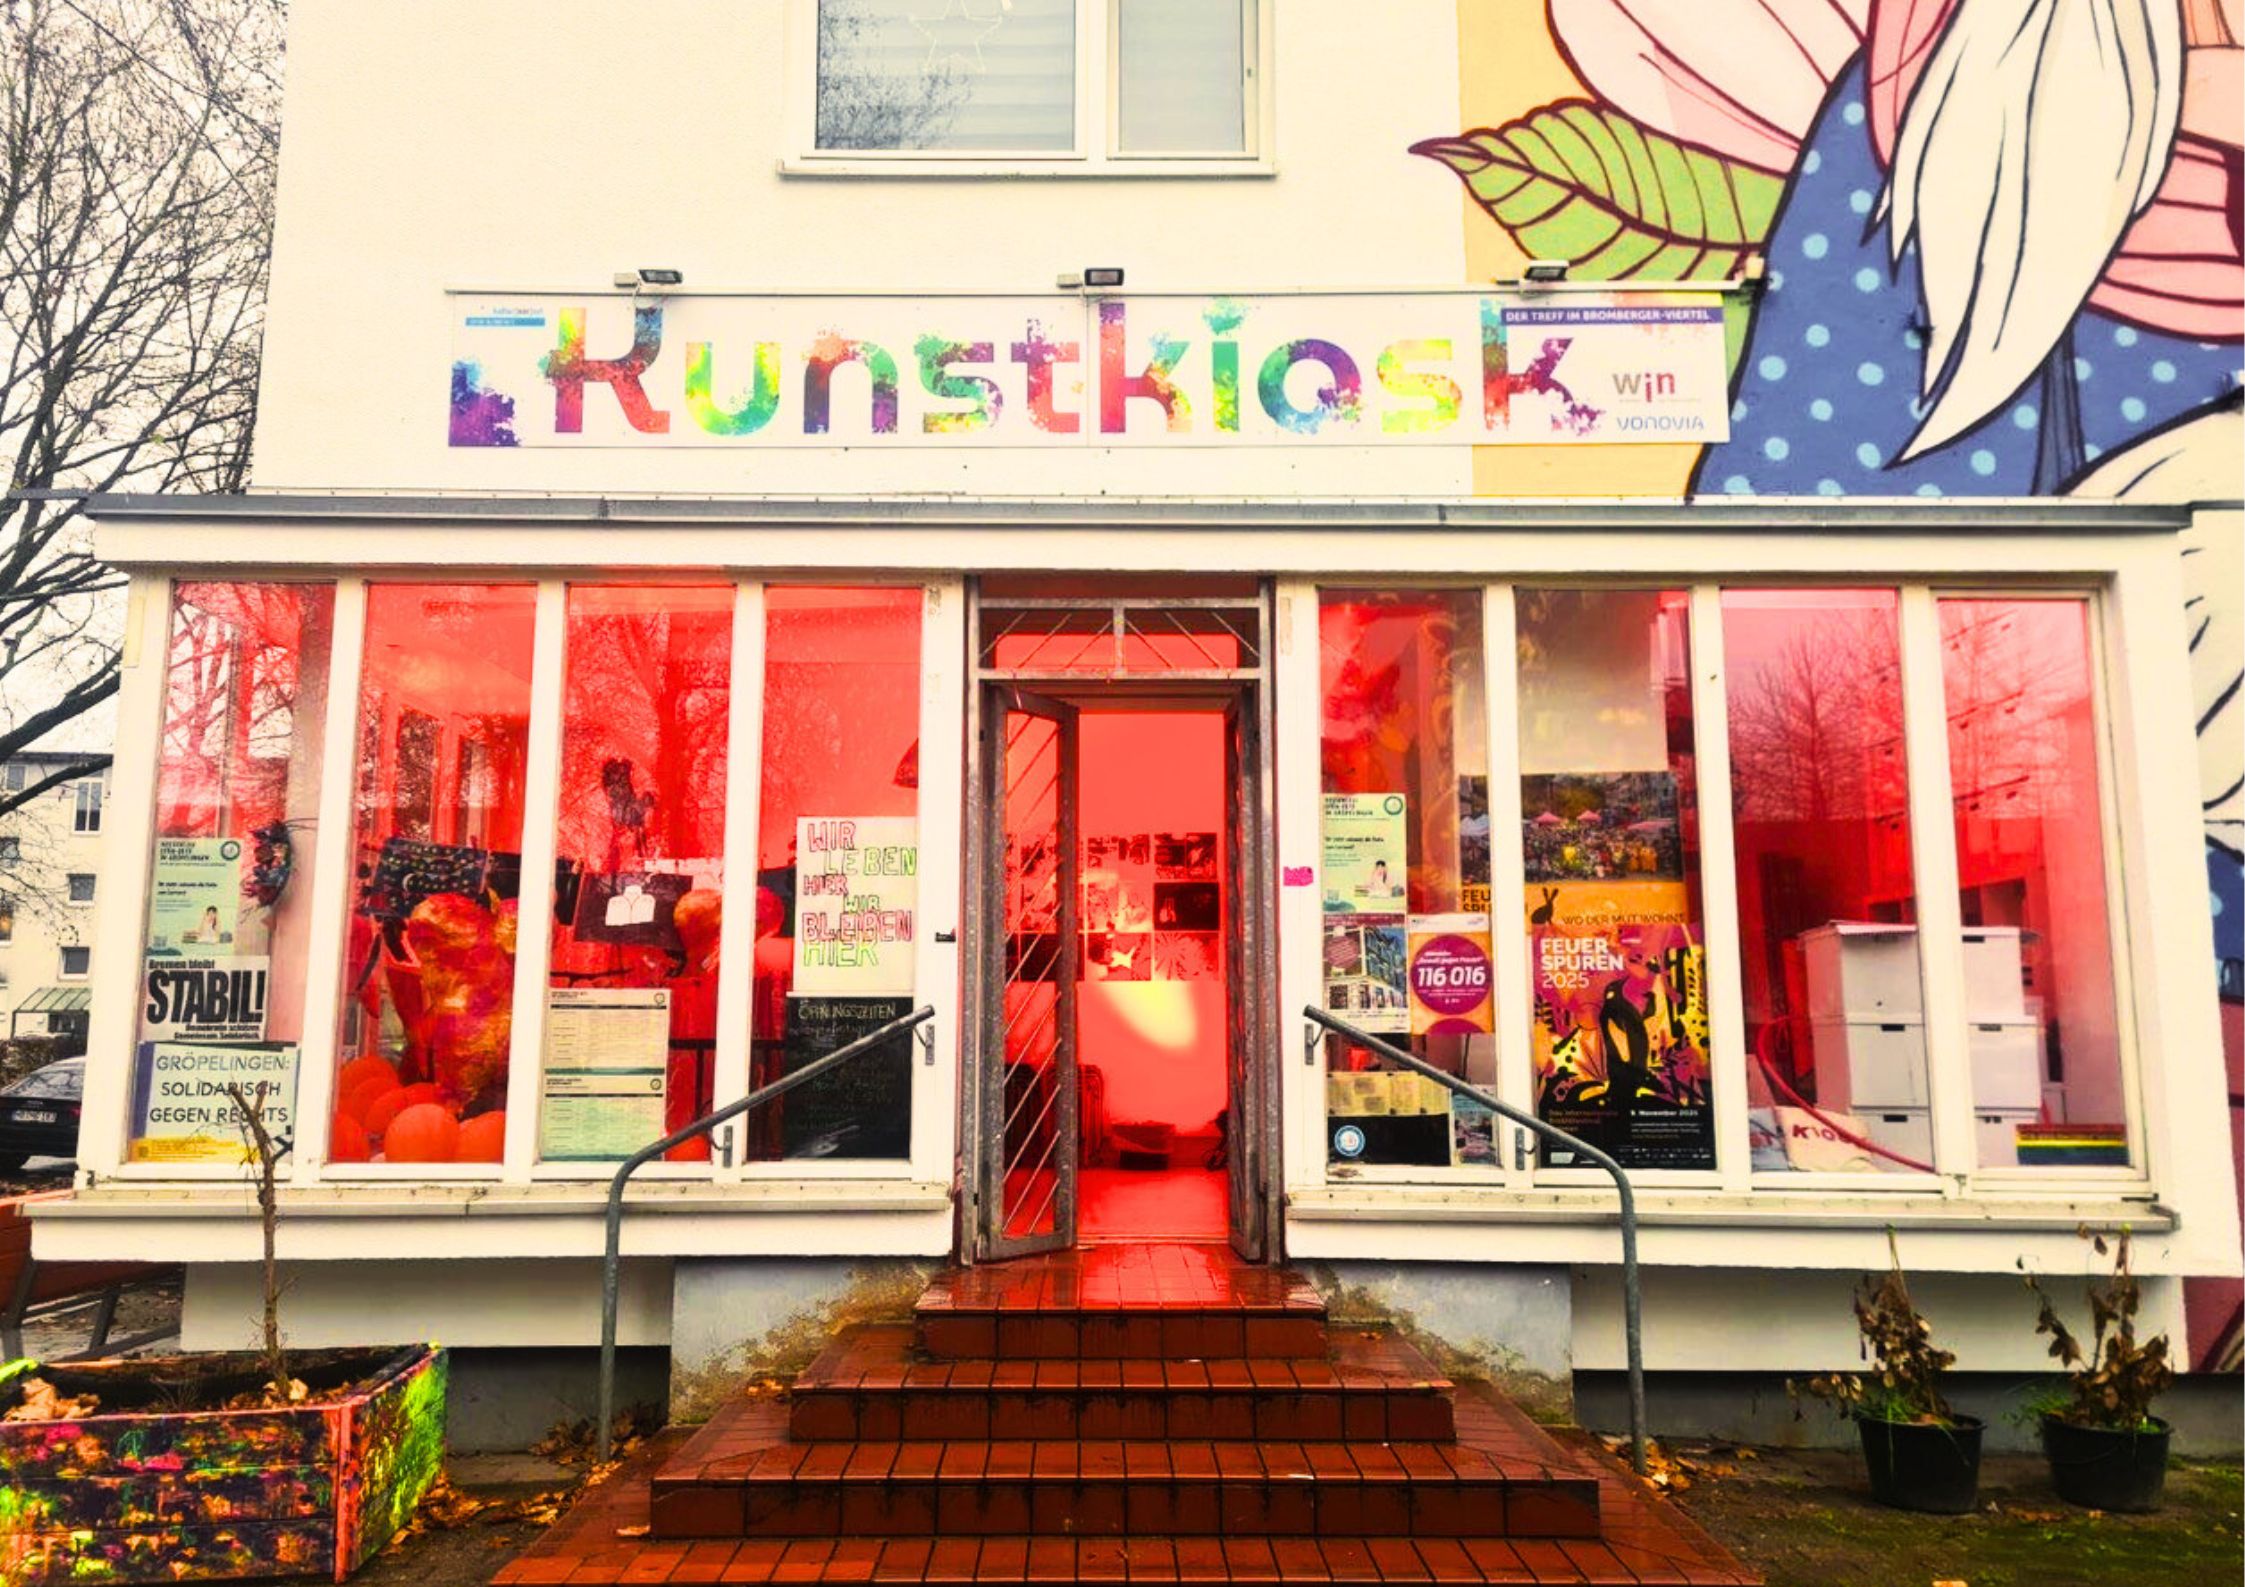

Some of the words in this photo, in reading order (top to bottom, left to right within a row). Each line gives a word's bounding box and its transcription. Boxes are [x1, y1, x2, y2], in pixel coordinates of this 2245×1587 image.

[1505, 310, 1529, 322] DER
[1532, 310, 1564, 322] TREFF
[1566, 310, 1582, 321] IM
[1582, 308, 1710, 321] BROMBERGER-VIERTEL
[540, 298, 1604, 436] Kunstkiosk
[807, 821, 856, 852] WIR
[823, 847, 917, 876] LEBEN
[803, 874, 849, 896] HIER
[843, 894, 881, 914] WIR
[1462, 889, 1491, 902] FEU
[801, 909, 913, 943] BLEIBEN
[1562, 914, 1585, 925] WO
[1586, 914, 1610, 925] DER
[1611, 913, 1636, 923] MUT
[803, 938, 879, 967] HIER
[1540, 937, 1609, 954] FEUER
[1540, 955, 1625, 971] SPUREN
[1418, 967, 1447, 987] 116
[1450, 966, 1486, 986] 016
[1542, 972, 1590, 989] 2025
[147, 969, 267, 1025] STABIL!
[156, 1052, 290, 1072] GRÖPELINGEN:
[150, 1107, 210, 1123] GEGEN
